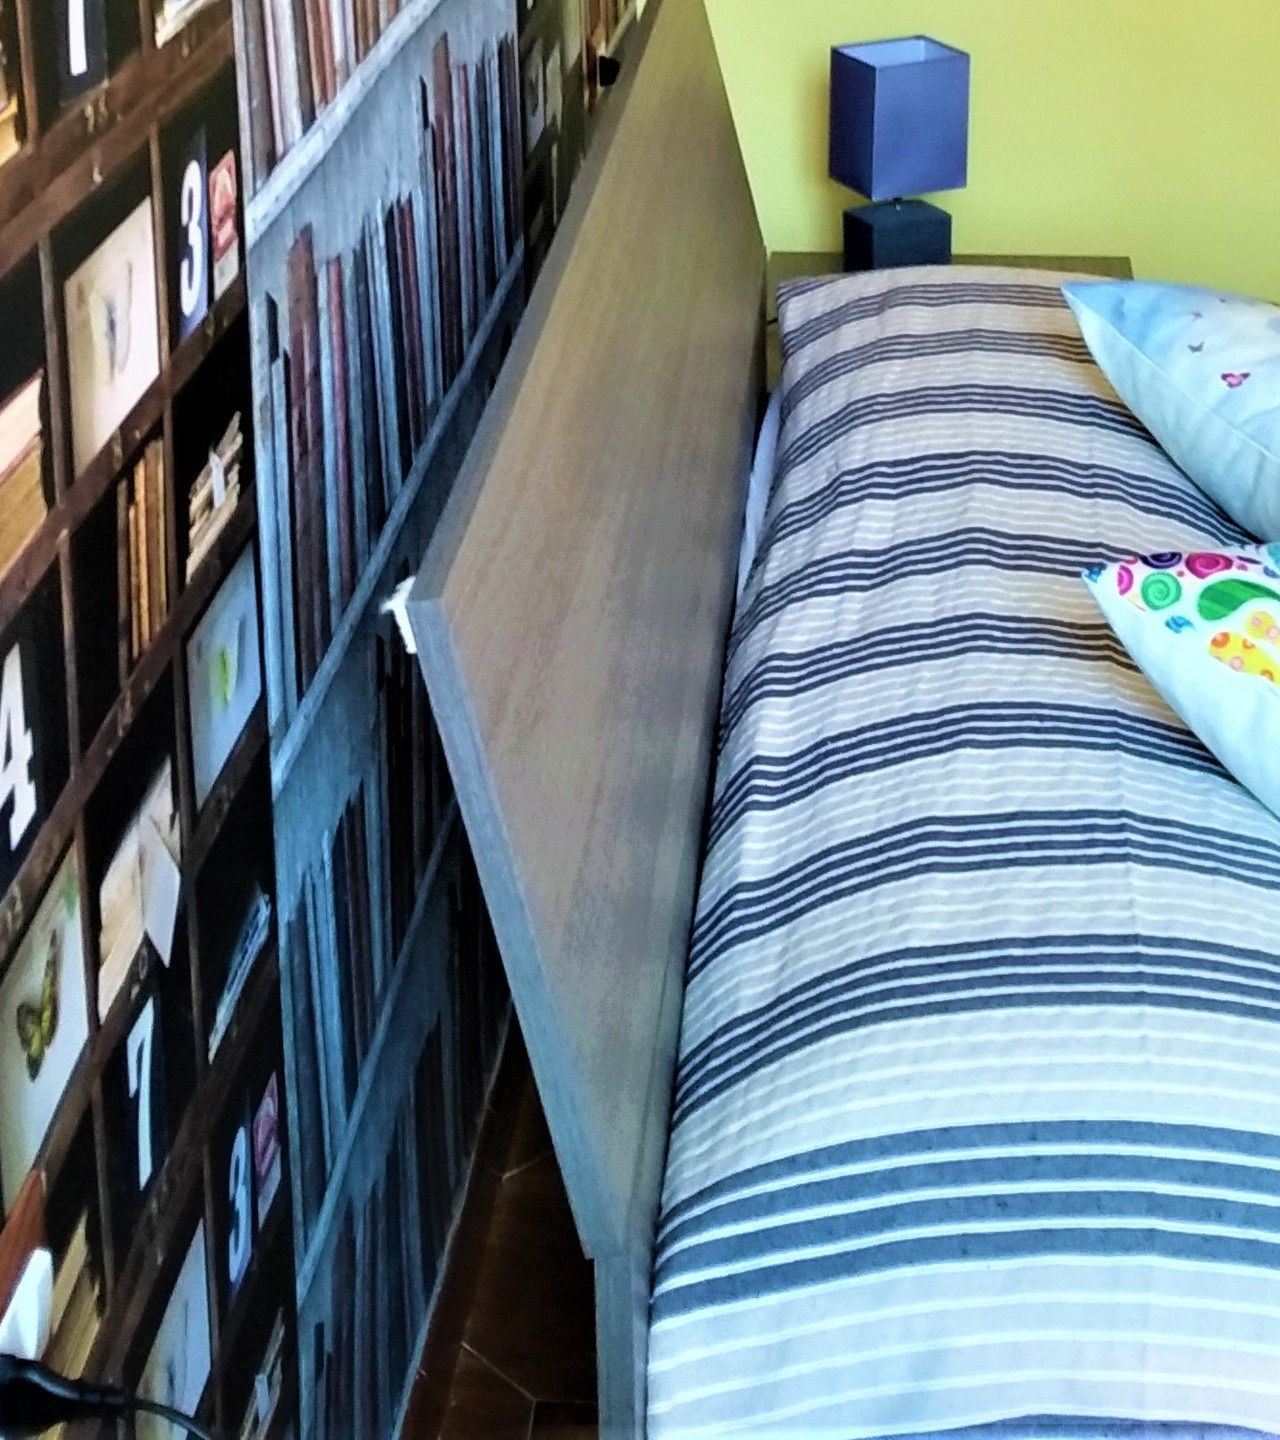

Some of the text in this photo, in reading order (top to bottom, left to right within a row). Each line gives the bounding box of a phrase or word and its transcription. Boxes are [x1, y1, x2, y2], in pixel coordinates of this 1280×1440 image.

[180, 159, 203, 317] 3
[126, 995, 154, 1192] 7
[228, 1126, 247, 1284] 3
